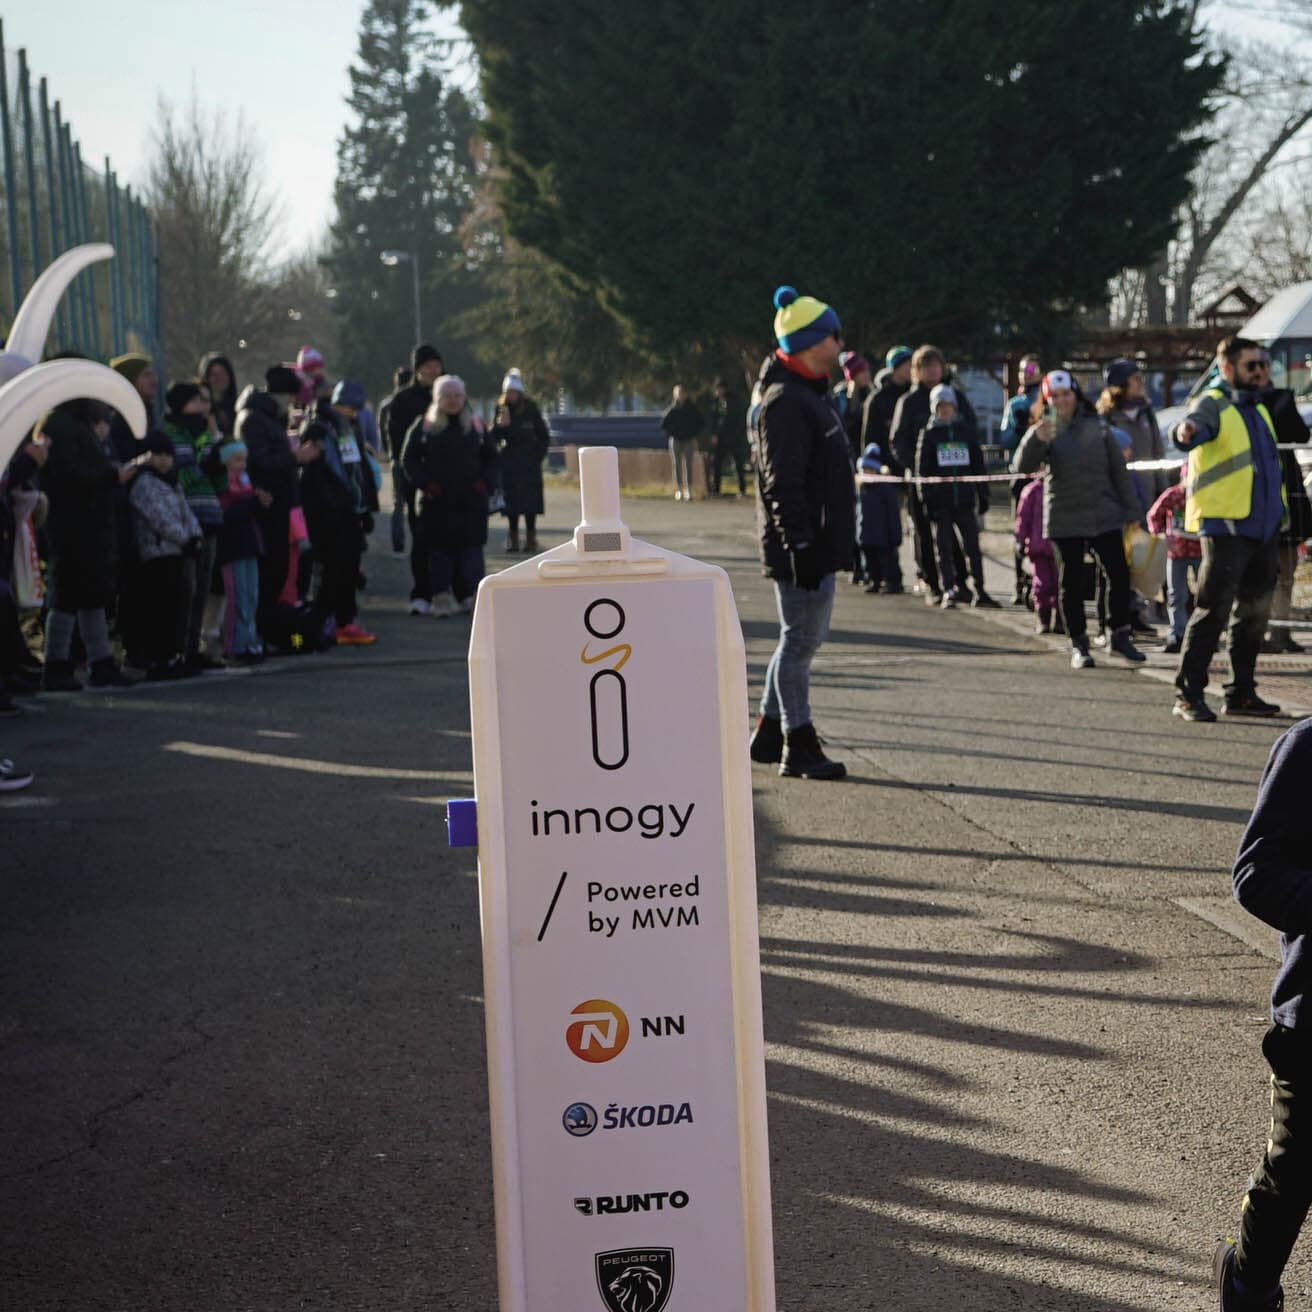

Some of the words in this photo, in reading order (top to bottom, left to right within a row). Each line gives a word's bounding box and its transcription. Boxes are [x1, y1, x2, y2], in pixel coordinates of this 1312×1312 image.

[531, 800, 695, 839] innogy
[587, 875, 700, 903] Powered
[588, 910, 620, 938] by
[632, 906, 700, 930] MVM
[641, 1015, 685, 1038] NN
[603, 1102, 694, 1130] ŠKODA
[596, 1190, 690, 1215] RUNTO
[602, 1254, 667, 1267] PEUGEOT
